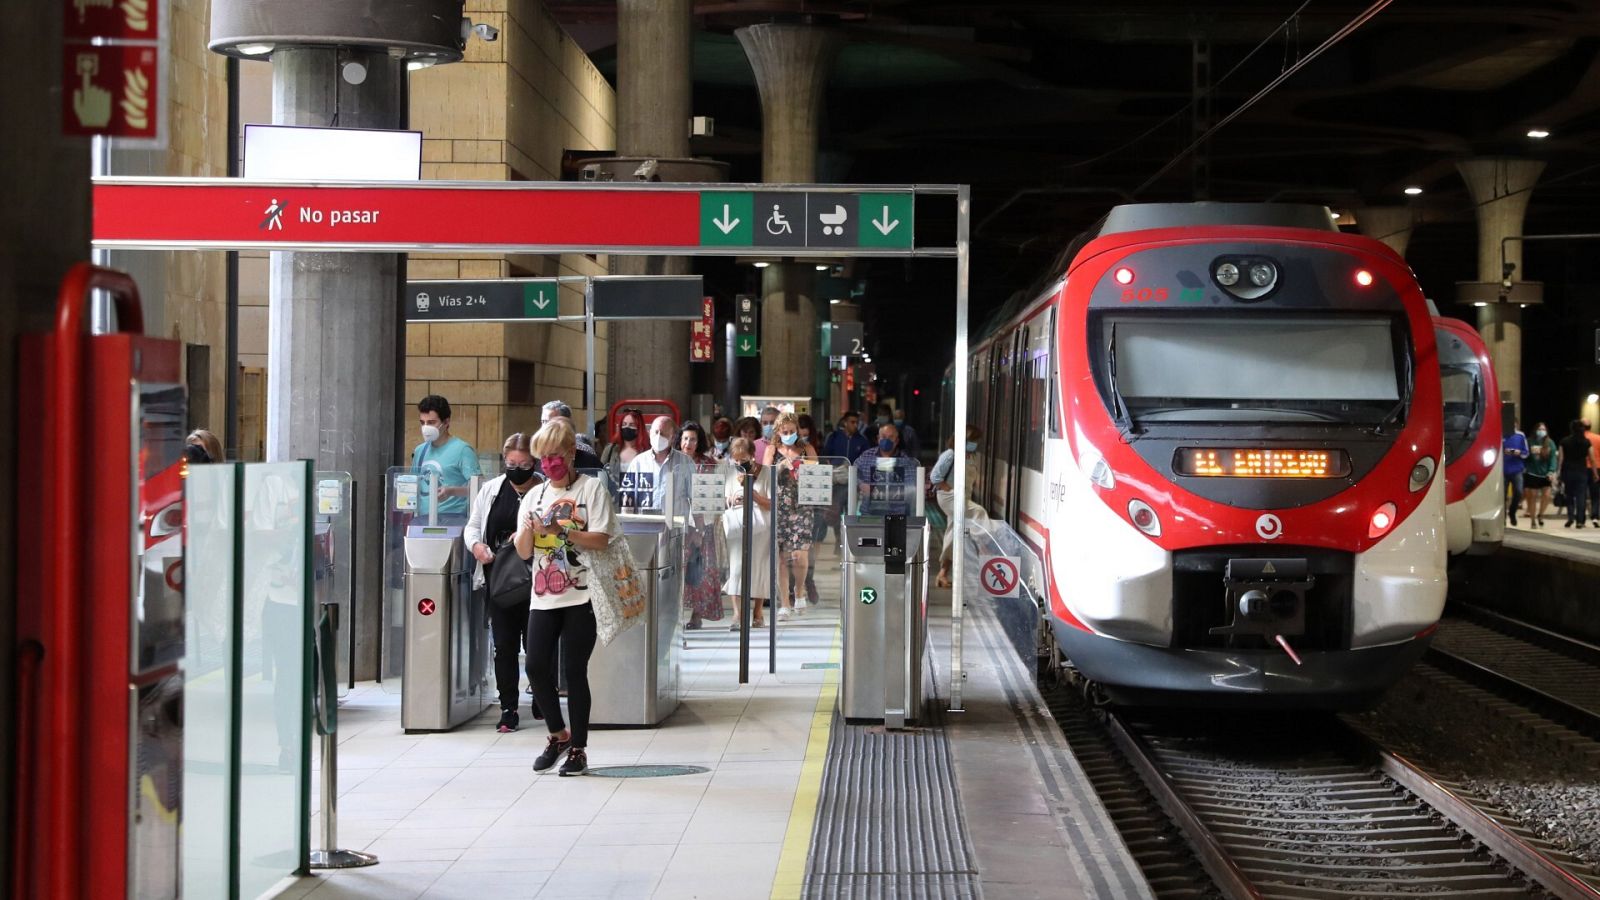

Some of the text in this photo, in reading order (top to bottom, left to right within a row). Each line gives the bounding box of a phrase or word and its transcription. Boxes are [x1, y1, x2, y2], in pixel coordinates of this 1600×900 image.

[300, 207, 380, 227] No pasar
[438, 294, 462, 307] Vías
[1120, 287, 1169, 303] 505
[740, 315, 752, 324] Vía
[851, 338, 861, 355] 2
